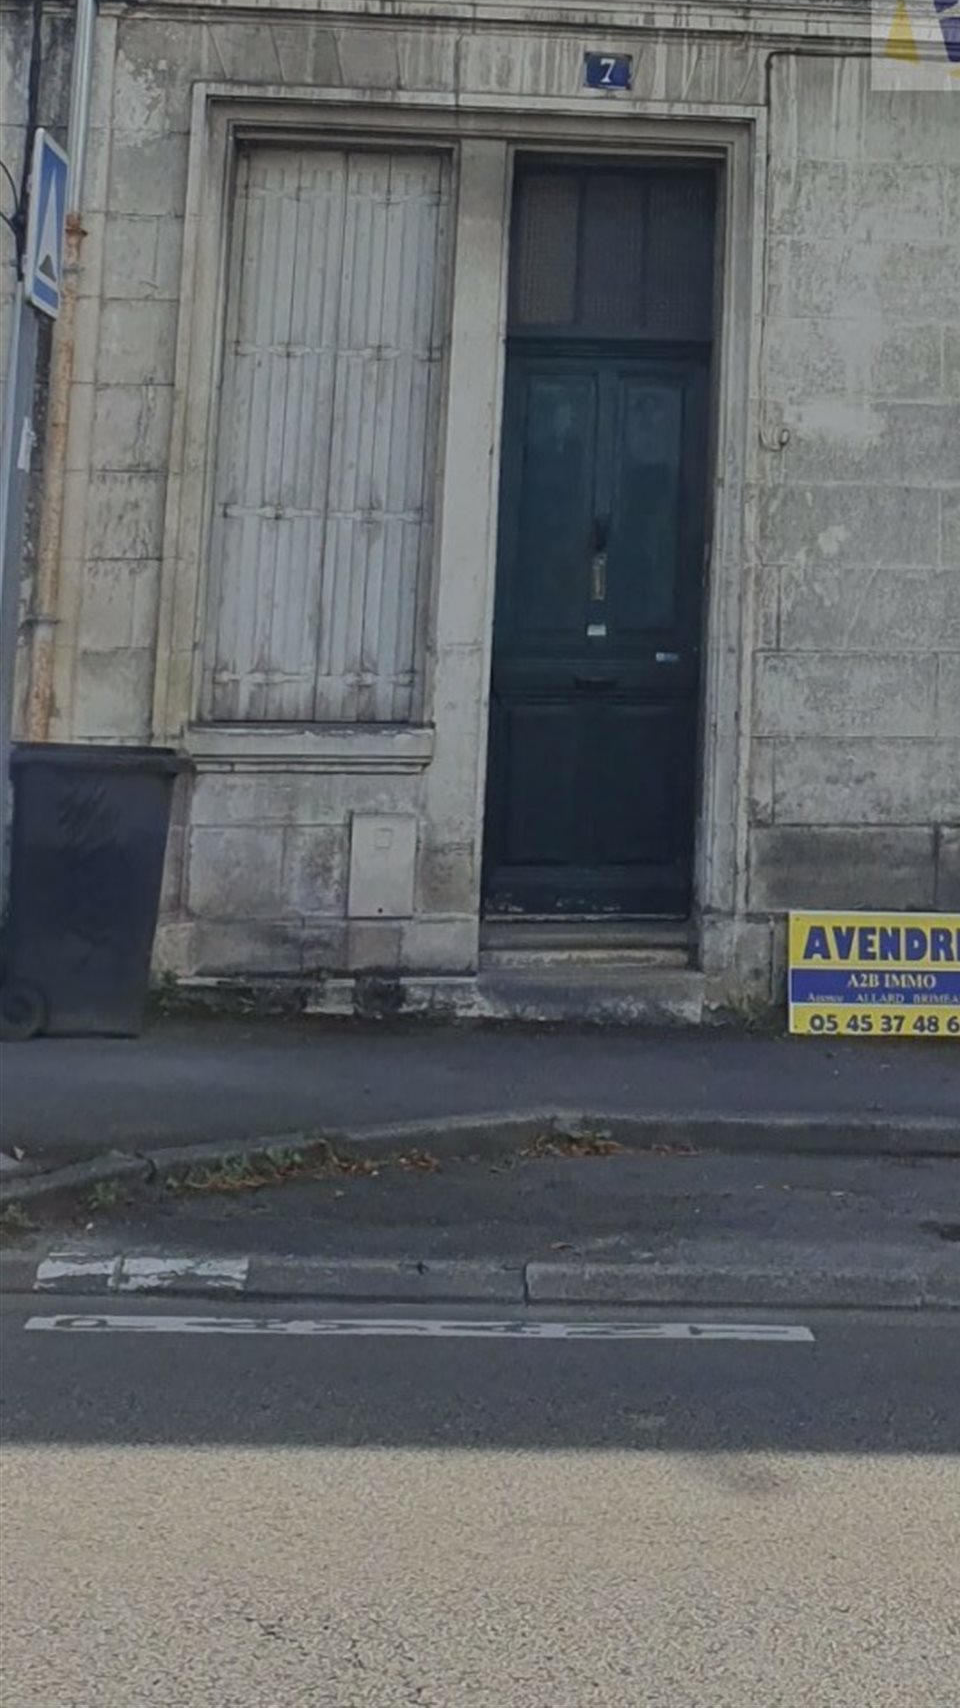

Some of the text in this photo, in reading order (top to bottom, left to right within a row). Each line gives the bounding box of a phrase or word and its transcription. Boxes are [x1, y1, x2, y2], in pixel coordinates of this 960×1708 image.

[600, 58, 616, 83] 7
[847, 973, 937, 990] A2B IMMO
[855, 993, 905, 1004] ALLARD
[809, 1013, 838, 1032] 05
[846, 1014, 873, 1032] 45
[880, 1015, 905, 1032] 37
[913, 1015, 940, 1033] 48
